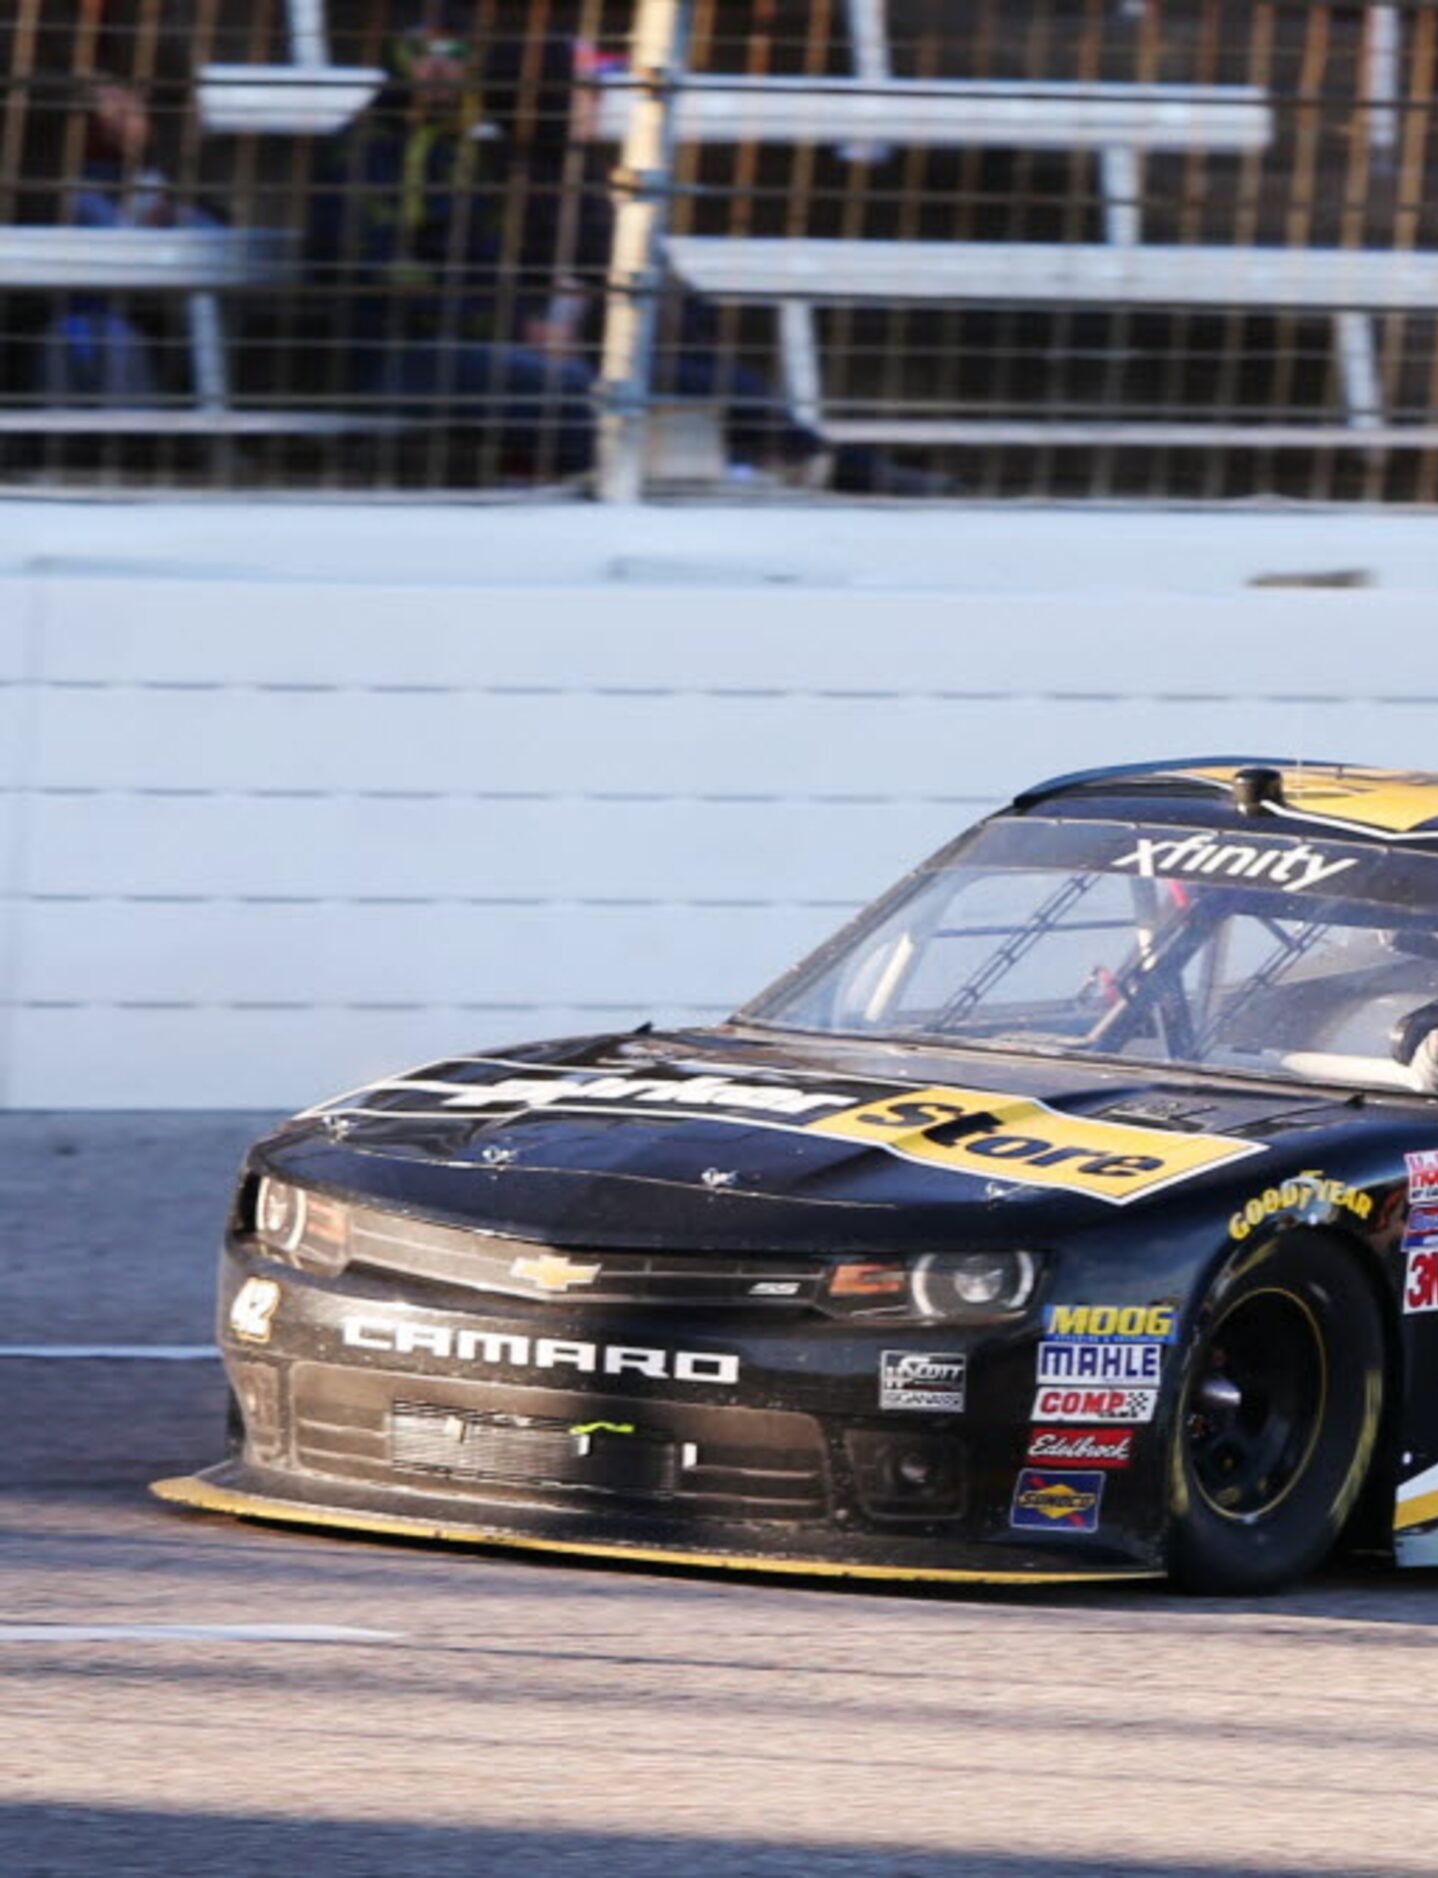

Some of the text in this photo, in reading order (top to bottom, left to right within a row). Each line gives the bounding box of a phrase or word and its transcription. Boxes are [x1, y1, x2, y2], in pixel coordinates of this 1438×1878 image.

[1112, 836, 1359, 892] xfinity
[858, 1102, 1165, 1177] Store
[1050, 1306, 1173, 1335] MOOG
[341, 1316, 739, 1384] CAMARO
[1041, 1346, 1157, 1377] MAHLE
[1040, 1391, 1125, 1415] COMP
[1028, 1433, 1130, 1459] Edelbrock
